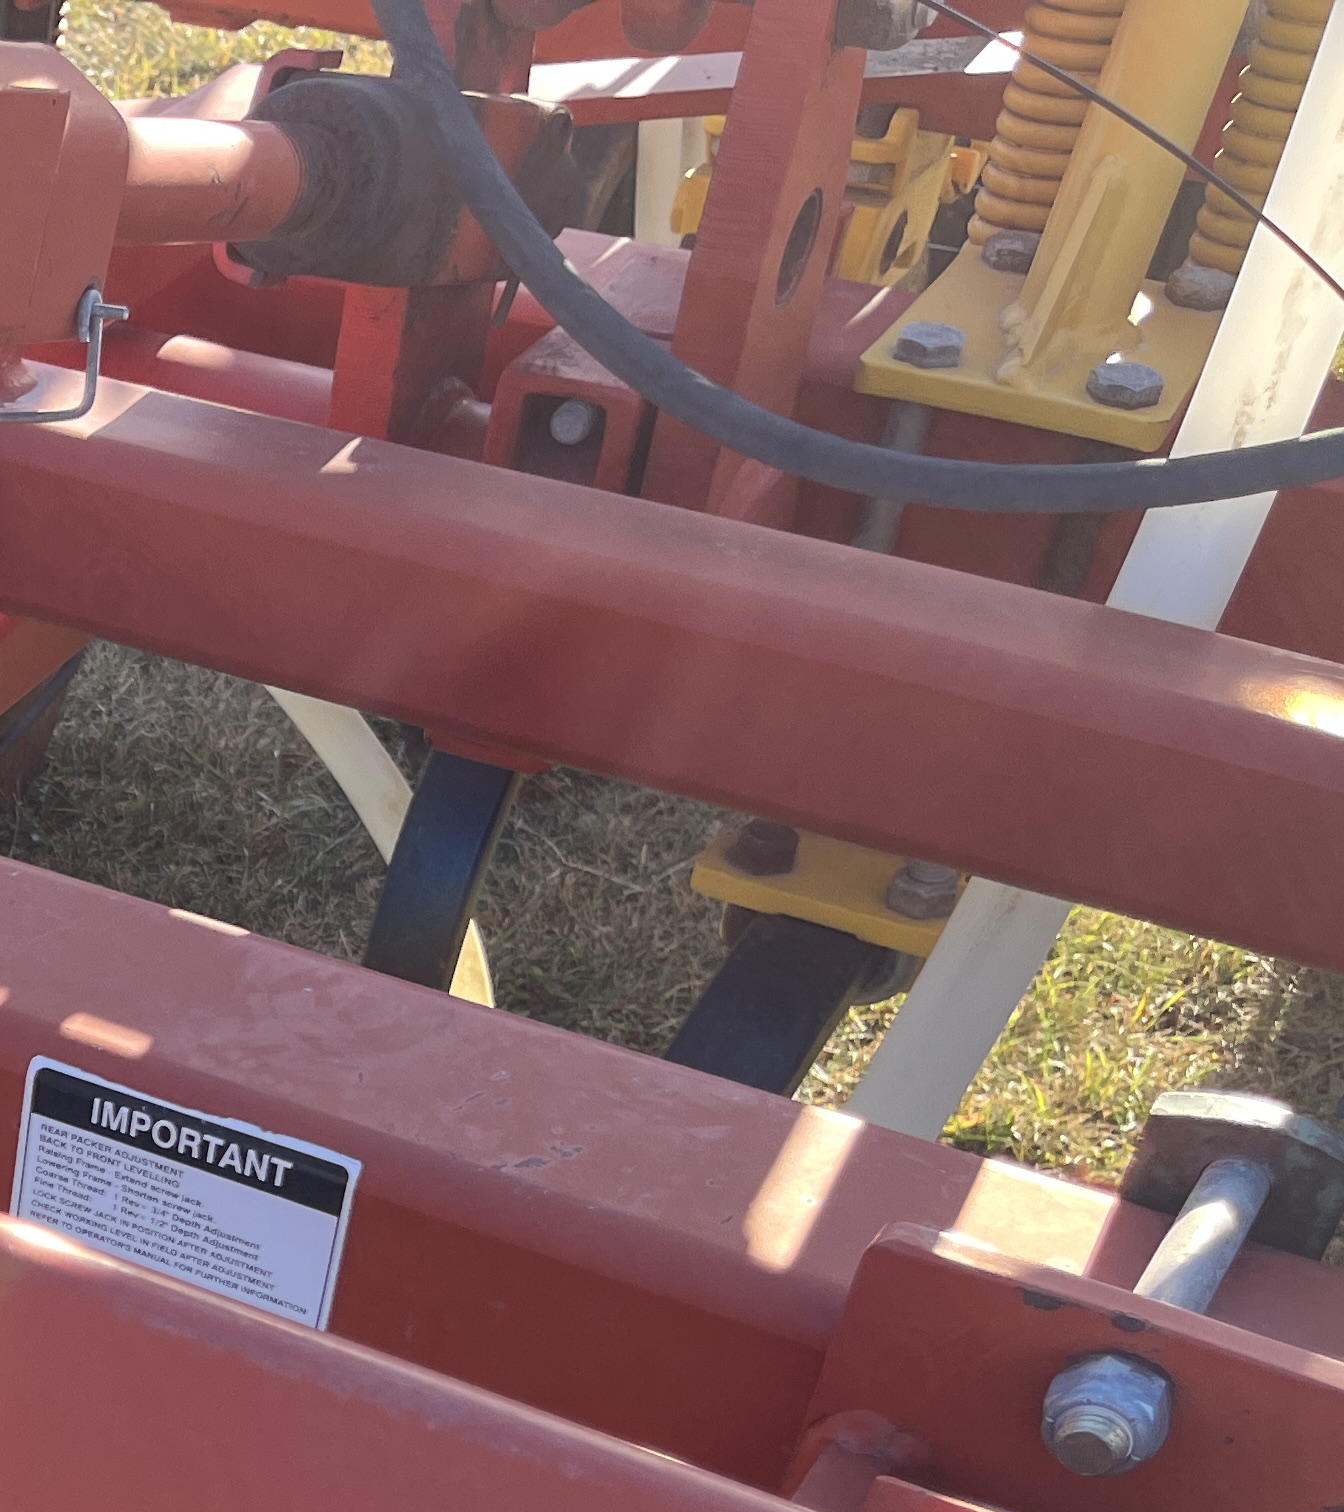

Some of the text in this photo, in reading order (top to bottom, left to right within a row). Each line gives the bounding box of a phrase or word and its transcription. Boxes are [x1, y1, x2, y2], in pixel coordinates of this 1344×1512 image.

[36, 1154, 79, 1178] Lowering
[82, 1170, 111, 1187] Frame
[120, 1183, 158, 1204] Shorten
[161, 1199, 190, 1215] screw
[37, 1143, 73, 1165] Raising
[75, 1156, 106, 1174] Frame
[113, 1170, 147, 1188] Extend
[150, 1184, 179, 1199] screw
[39, 1133, 179, 1189] BACK TO FRONT LEVELLING
[40, 1122, 184, 1178] REAR PACKER ADJUSTMENT
[90, 1097, 293, 1188] IMPORTANT
[30, 1198, 275, 1292] CHECK WORKING LEVEL IN FIELD AFTER ADJUSTMENT
[32, 1187, 272, 1279] LOCK SCREW JACK IN POSITION AFTER ADJUSTMENT
[33, 1175, 53, 1189] Fine
[119, 1206, 138, 1219] Rev
[170, 1224, 199, 1241] Depth
[202, 1235, 258, 1263] Adjustment
[35, 1165, 69, 1183] Coarse
[121, 1195, 139, 1208] Rev
[171, 1212, 201, 1231] Depth
[203, 1224, 260, 1252] Adjustment
[29, 1209, 58, 1225] REFER
[61, 1220, 72, 1231] TO
[133, 1246, 171, 1266] MANUAL
[173, 1260, 192, 1274] FOR
[194, 1268, 238, 1290] FURTHER
[240, 1285, 306, 1315] INFORMATION
